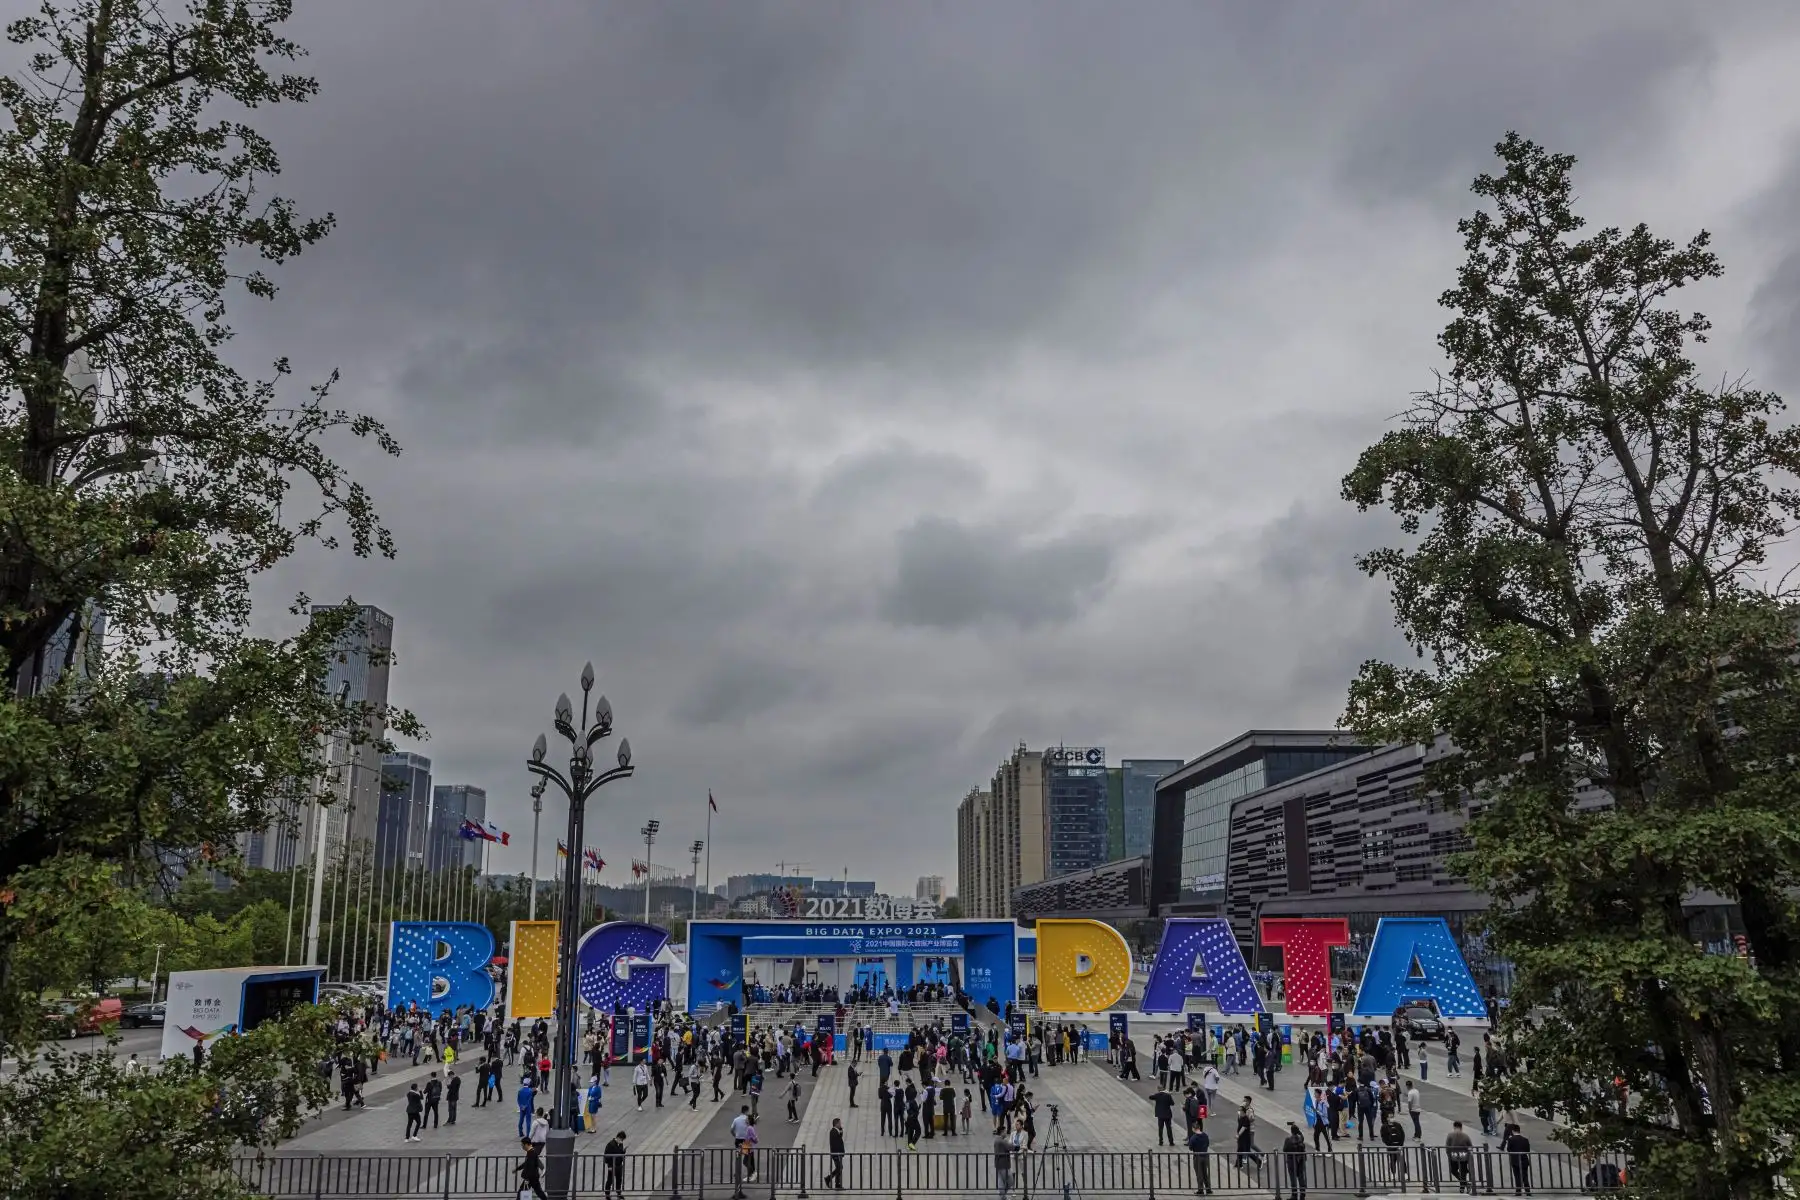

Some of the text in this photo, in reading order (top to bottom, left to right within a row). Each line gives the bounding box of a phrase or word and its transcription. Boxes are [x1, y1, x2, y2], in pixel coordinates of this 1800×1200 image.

[805, 927, 937, 936] BIG DATA EXPO 2021
[388, 917, 1489, 1019] BIG DATA
